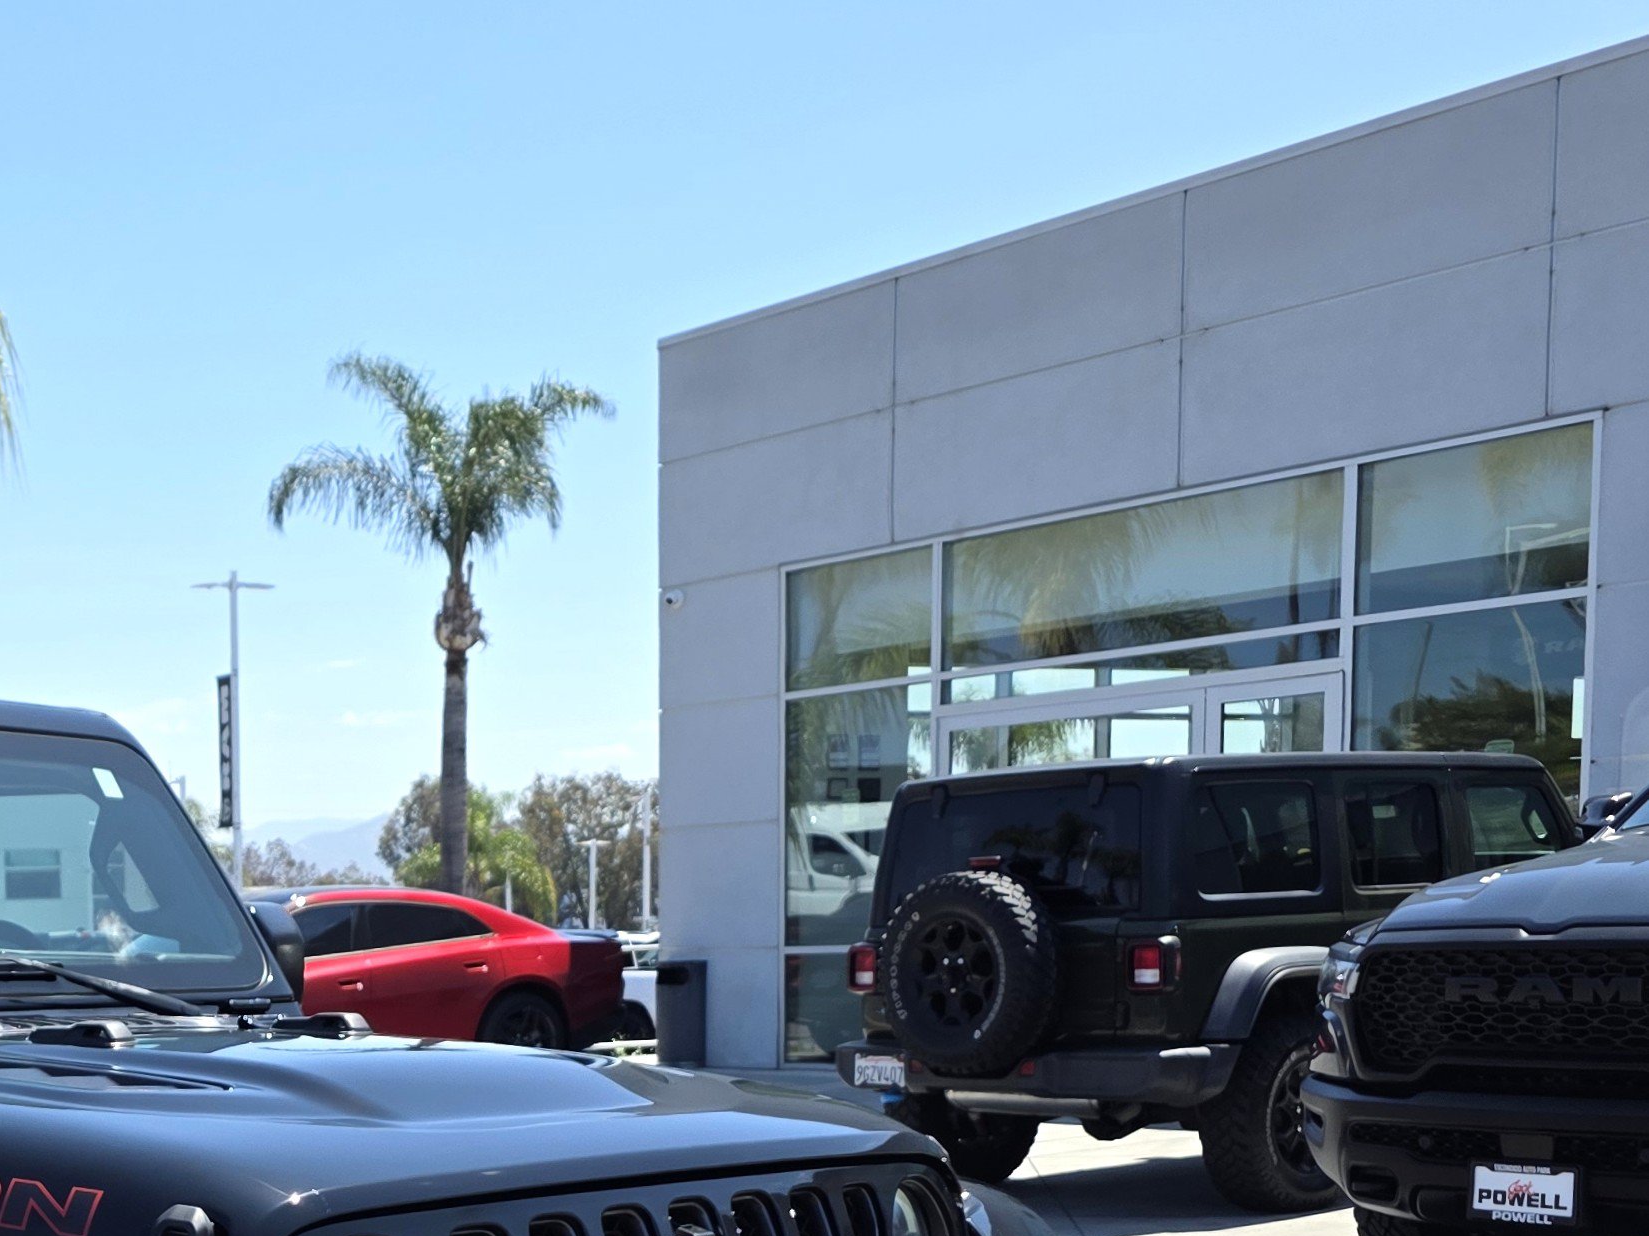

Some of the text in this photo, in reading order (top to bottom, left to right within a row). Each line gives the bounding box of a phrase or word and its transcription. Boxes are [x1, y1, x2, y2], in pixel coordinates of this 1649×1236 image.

[1444, 975, 1642, 1002] RAM
[856, 1064, 903, 1083] 9GZV407
[1478, 1188, 1567, 1210] POWELL
[1491, 1210, 1553, 1226] POWELL
